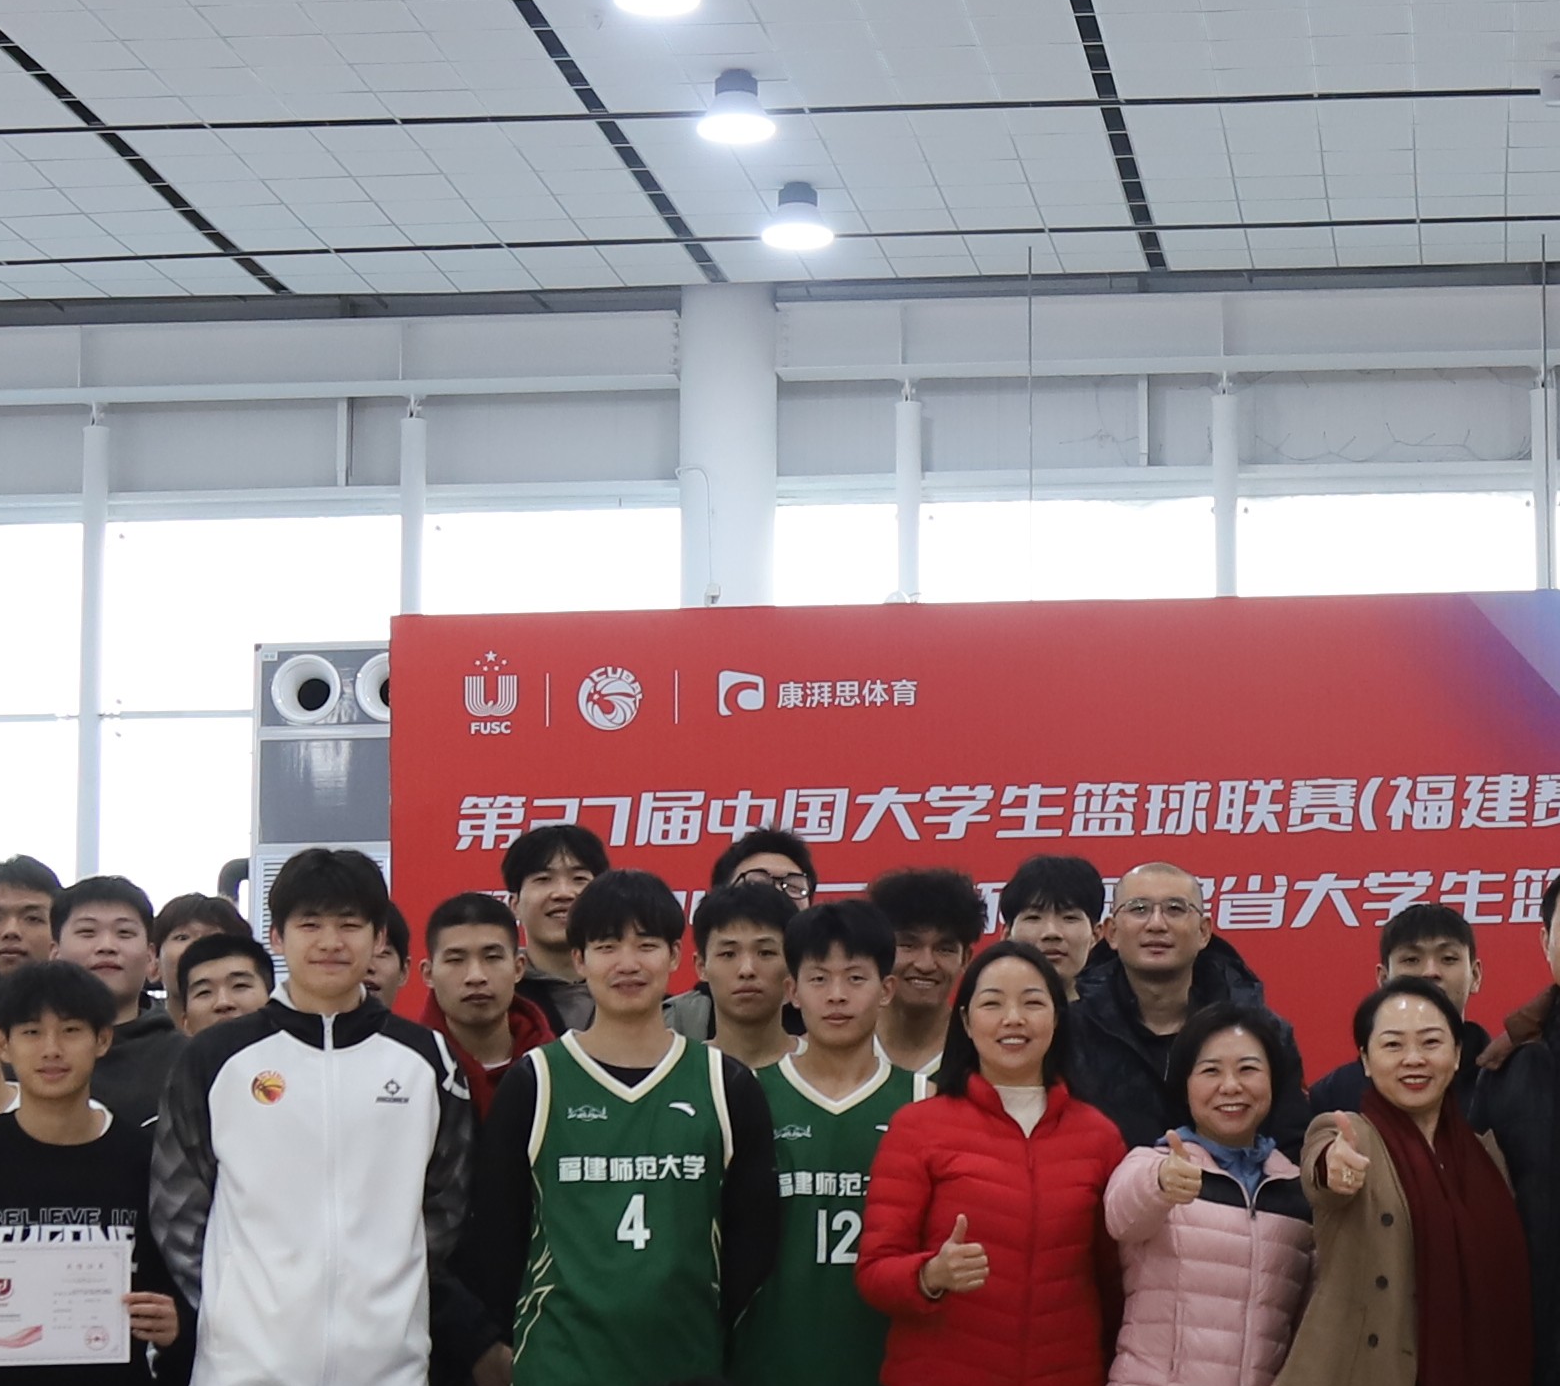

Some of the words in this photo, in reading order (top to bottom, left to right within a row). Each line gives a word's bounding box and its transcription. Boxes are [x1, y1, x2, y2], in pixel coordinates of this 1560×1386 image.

[777, 679, 918, 709] 康湃思体育
[470, 722, 512, 735] FUSC
[558, 1155, 706, 1182] 福建师范大学
[111, 1210, 138, 1228] IN
[616, 1194, 652, 1250] 4
[817, 1209, 862, 1264] 12
